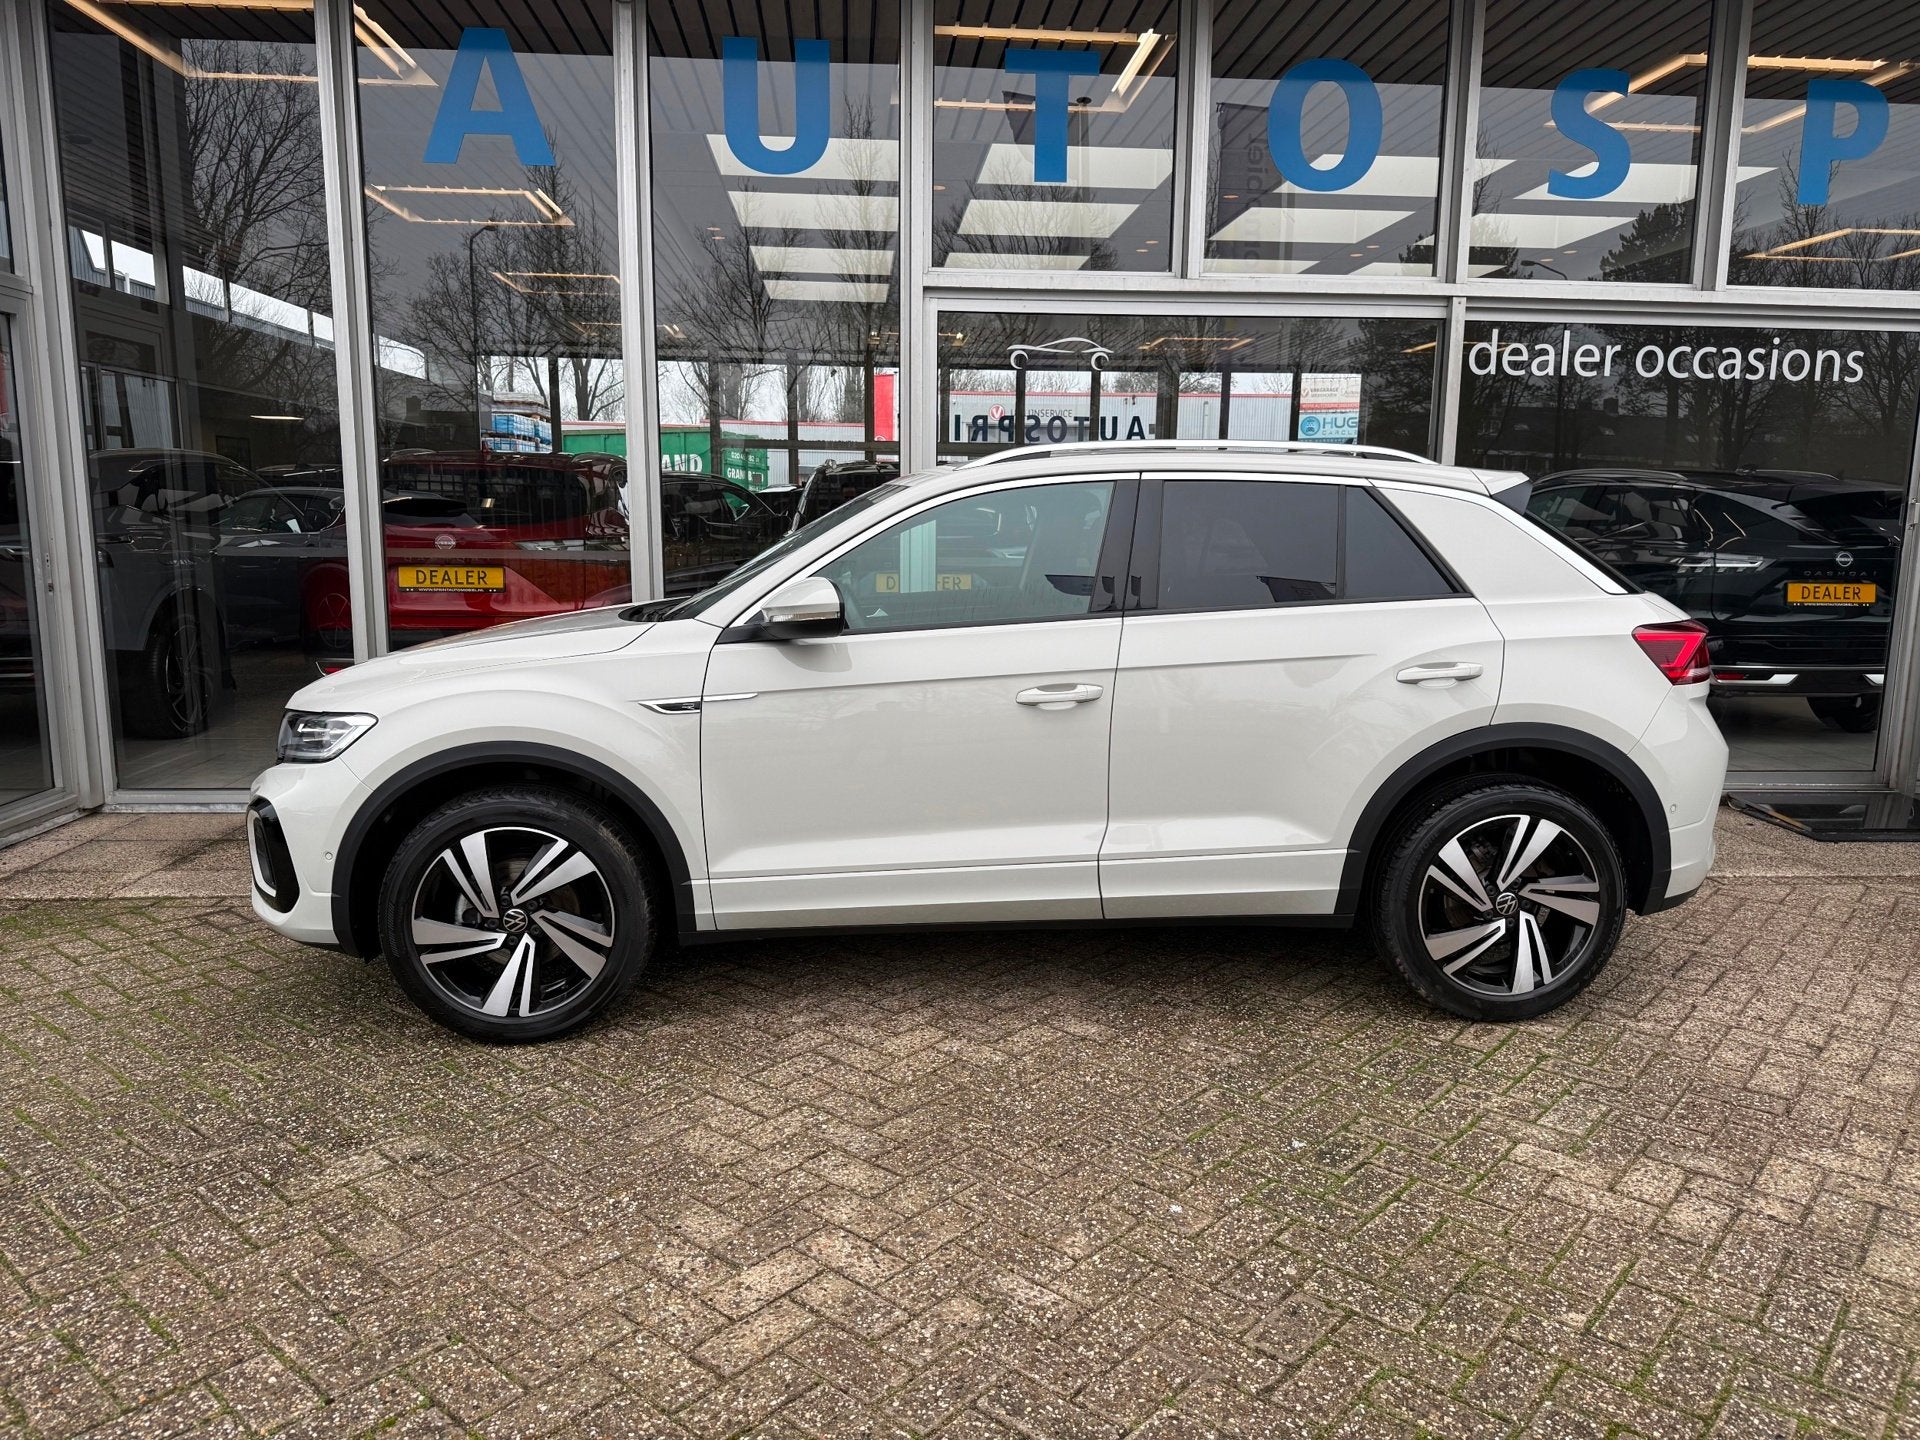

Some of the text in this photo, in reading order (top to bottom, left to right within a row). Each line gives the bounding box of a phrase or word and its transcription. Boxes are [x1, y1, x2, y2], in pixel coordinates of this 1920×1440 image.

[1468, 328, 1865, 384] dealer occasions
[727, 467, 746, 480] GRAN
[415, 569, 488, 585] DEALER
[886, 576, 962, 591] DER
[1801, 585, 1861, 600] DEALER
